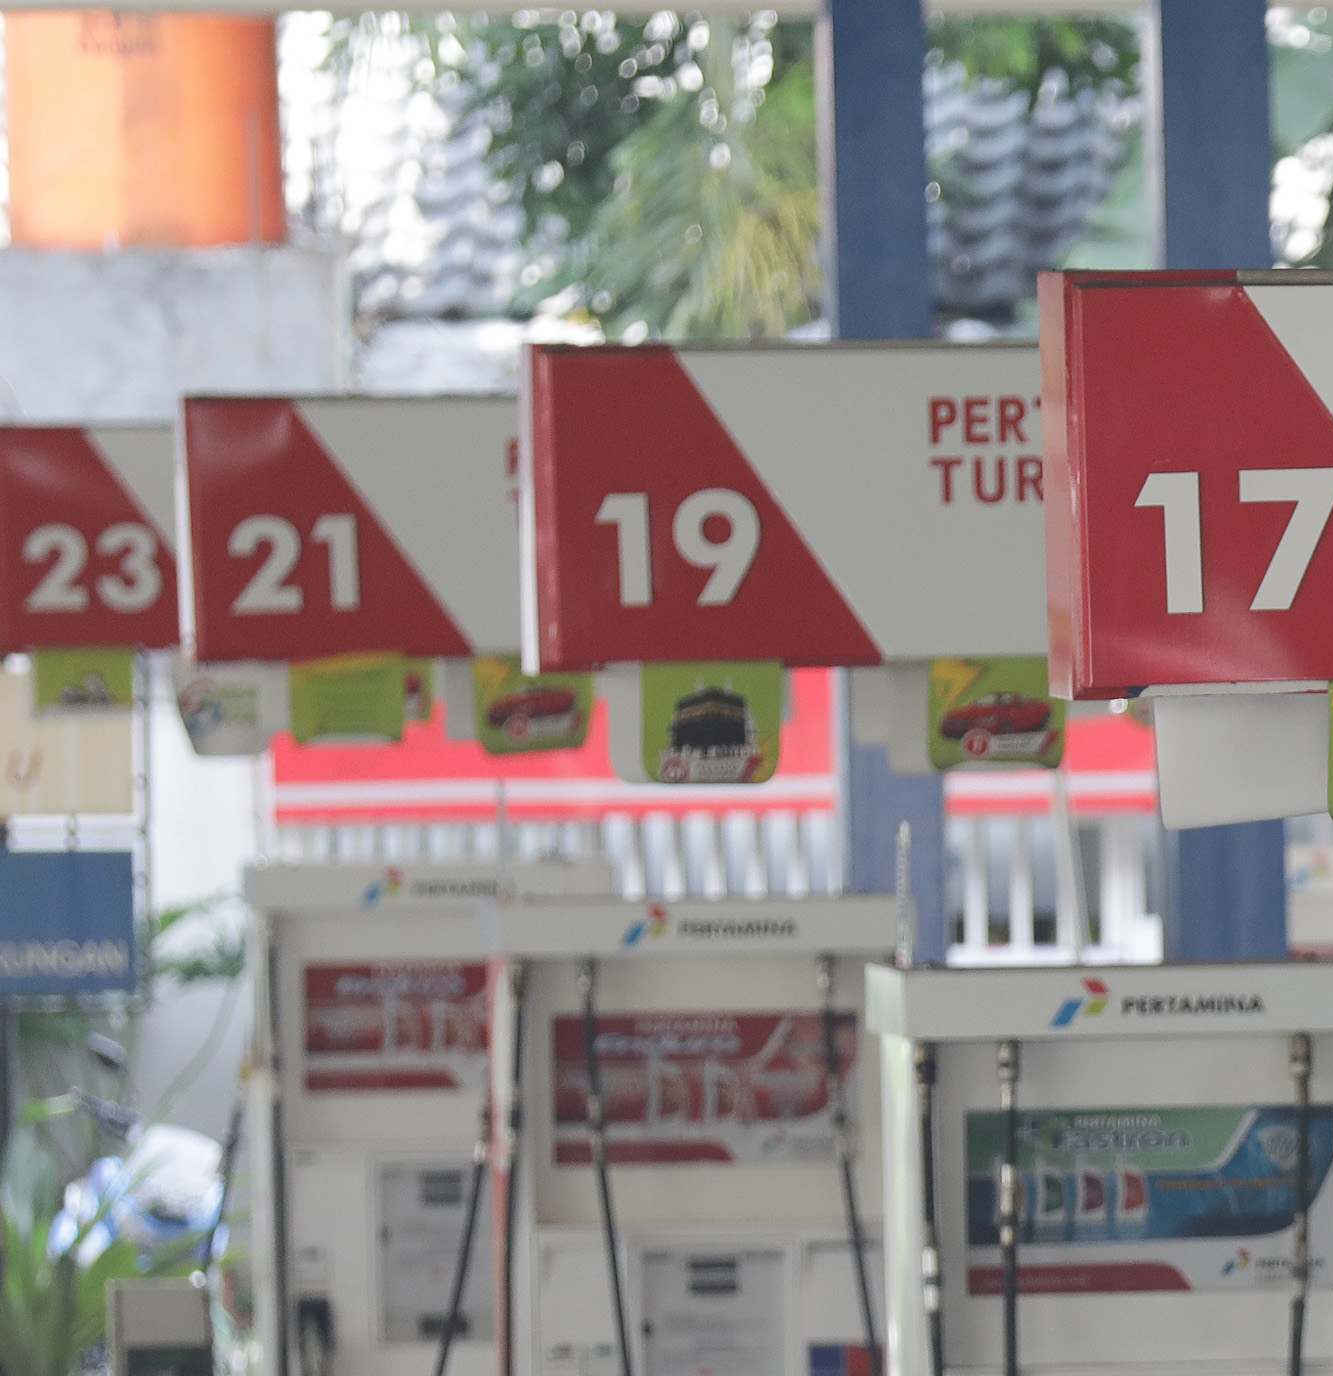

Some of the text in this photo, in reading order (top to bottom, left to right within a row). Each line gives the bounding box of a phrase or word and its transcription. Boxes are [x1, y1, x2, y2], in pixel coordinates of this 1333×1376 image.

[928, 395, 1041, 444] PER
[22, 521, 163, 614] 23
[228, 513, 362, 615] 21
[595, 487, 762, 607] 19
[1120, 994, 1266, 1017] PERTAMINA
